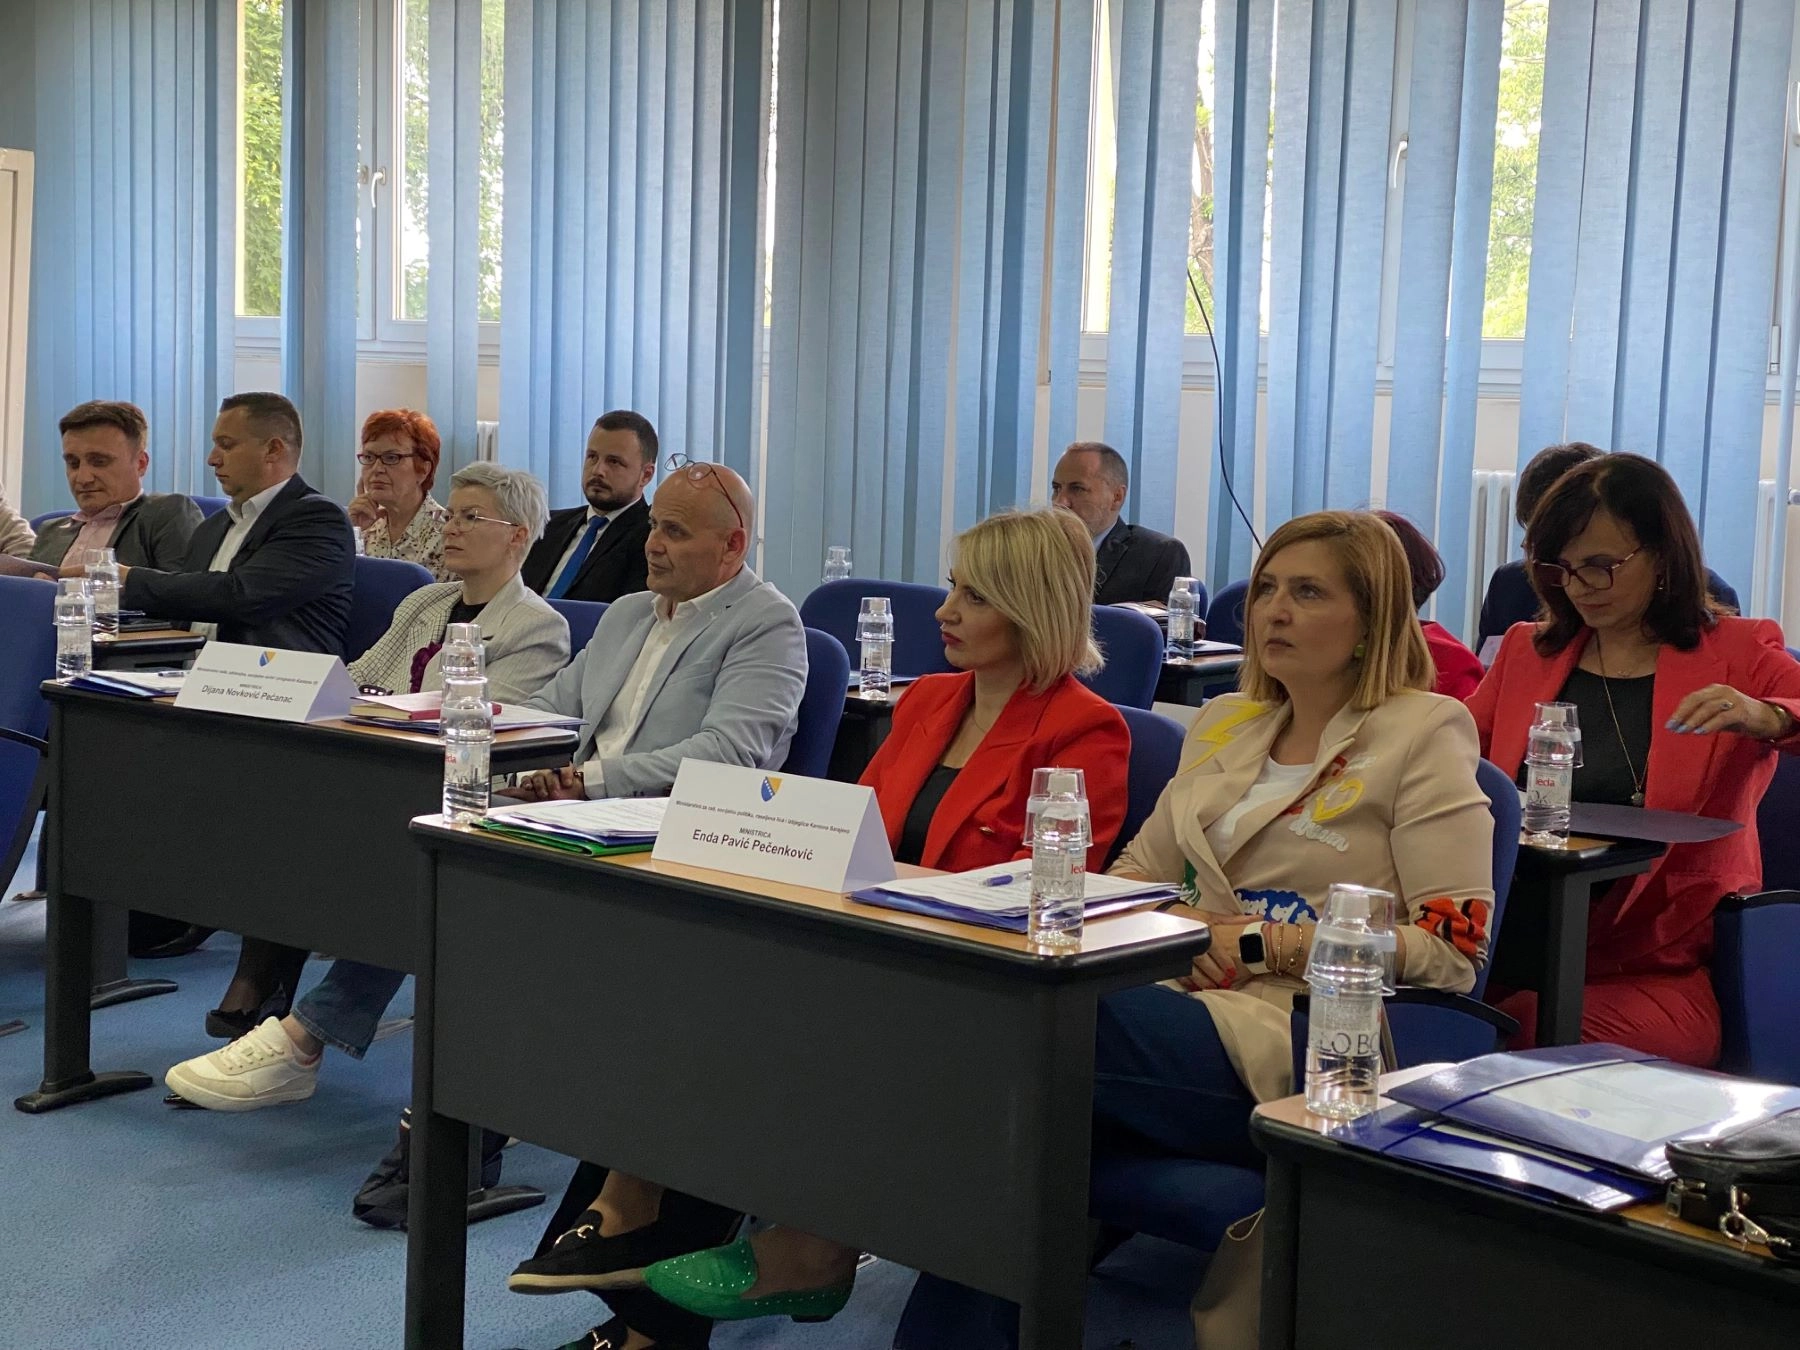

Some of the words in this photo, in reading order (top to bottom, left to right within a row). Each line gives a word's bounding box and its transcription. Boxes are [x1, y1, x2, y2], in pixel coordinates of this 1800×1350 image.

[202, 685, 225, 695] Dijana
[226, 688, 260, 699] Novković
[739, 827, 772, 838] MINISTRICA
[692, 829, 719, 844] Enda
[720, 834, 750, 849] Pavić
[751, 839, 814, 861] Pečenković
